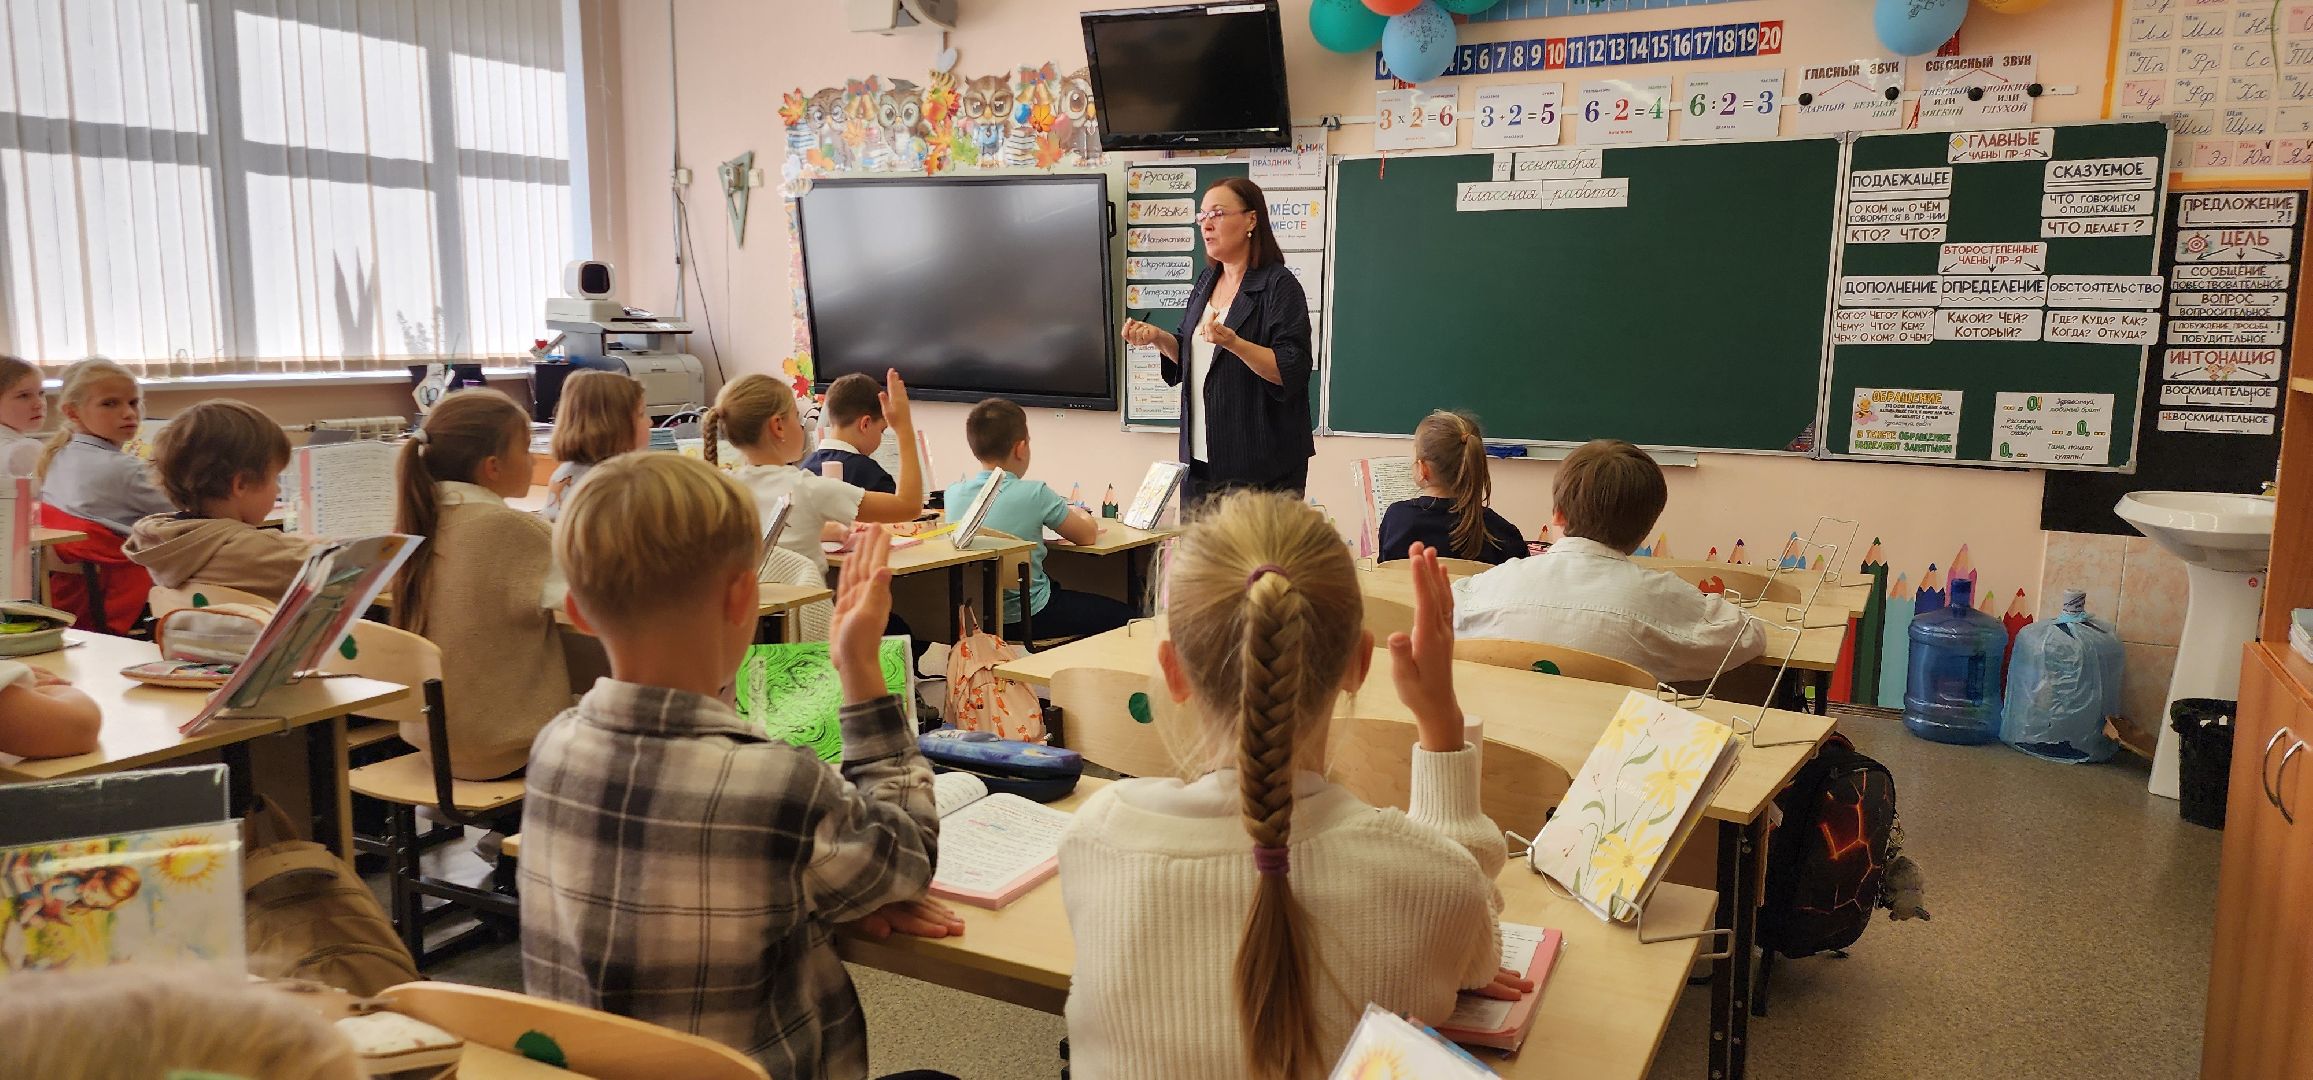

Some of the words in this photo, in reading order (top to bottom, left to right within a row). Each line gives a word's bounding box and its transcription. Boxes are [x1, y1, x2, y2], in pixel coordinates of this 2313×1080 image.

[1462, 49, 1472, 70] 5
[1480, 48, 1489, 69] 6
[1496, 47, 1507, 68] 7
[1512, 45, 1523, 67] 8
[1531, 45, 1542, 65] 9
[1548, 42, 1564, 65] 10
[1569, 41, 1584, 63] 11
[1588, 40, 1605, 62] 12
[1608, 39, 1625, 60] 13
[1630, 39, 1647, 59] 14
[1651, 36, 1669, 58] 15
[1673, 35, 1691, 56] 16
[1695, 32, 1712, 55] 17
[1716, 31, 1735, 53] 18
[1739, 29, 1757, 51] 19
[1760, 27, 1780, 50] 20
[1925, 56, 1994, 71] СОГЛАСНЫЙ
[2003, 55, 2031, 67] ЗВУК
[1805, 65, 1860, 80] ГЛАСНЫЙ
[1870, 62, 1899, 74] ЗВУК
[1690, 93, 1706, 116] 6
[1719, 93, 1736, 115] 2
[1757, 91, 1773, 114] 3
[1997, 94, 2019, 102] ИЛИ
[1480, 105, 1494, 127] 3
[1508, 104, 1522, 126] 2
[1541, 102, 1554, 124] 5
[1585, 100, 1599, 122] 6
[1614, 99, 1629, 121] 2
[1649, 97, 1664, 119] 4
[1981, 104, 2028, 114] ГЛУХОЙ
[1380, 109, 1392, 130] 3
[1410, 107, 1423, 128] 2
[1440, 105, 1453, 126] 6
[1968, 132, 2040, 148] ГЛАВНЫЕ
[1968, 151, 2001, 159] ЧЛЕНЫ
[2005, 150, 2031, 158] ПР-Я
[2053, 162, 2144, 177] СКАЗУЕМОЕ
[1852, 172, 1949, 187] ПОДЛЕЖАЩЕЕ
[2050, 194, 2074, 204] ЧТО
[2081, 194, 2140, 203] ГОВОРИТСЯ
[2184, 197, 2295, 211] ПРЕДЛОЖЕНИЕ
[1855, 205, 1862, 213] О
[1866, 204, 1887, 213] КОМ
[1909, 204, 1917, 212] О
[1920, 201, 1940, 211] ЧЁМ
[1850, 214, 1900, 222] ГОВОРИТСЯ
[2048, 222, 2081, 234] ЧТО
[2084, 222, 2129, 234] ДЕЛАЕТ
[1852, 229, 1890, 241] КТО?
[1901, 228, 1940, 240] ЧТО?
[2220, 231, 2269, 246] ЦЕЛЬ
[1944, 245, 2039, 254] ВТОРОСТЕПЕННЫЕ
[1959, 255, 1992, 264] ЧЛЕНЫ
[1996, 255, 2023, 264] ПР-Я
[2191, 266, 2266, 276] СООБЩЕНИЕ
[1845, 281, 1938, 294] ДОПОЛНЕНИЕ
[1942, 279, 2045, 294] ОПРЕДЕЛЕНИЕ
[2050, 283, 2162, 293] ОБСТОЯТЕЛЬСТВО
[2173, 280, 2282, 289] ПОВЕСТВОВАТЕЛЬНОЕ
[2201, 294, 2254, 304] ВОПРОС
[2180, 307, 2271, 315] ВОПРОСИТЕЛЬНОЕ
[2182, 335, 2266, 343] ПОБУДИТЕЛЬНОЕ
[2170, 351, 2275, 365] ИНТОНАЦИЯ
[2165, 386, 2271, 396] ВОСКЛИЦАТЕЛЬНОЕ
[1872, 391, 1942, 404] ОБРАЩЕНИЕ
[2162, 412, 2269, 424] НЕВОСКЛИЦАТЕЛЬНОЕ
